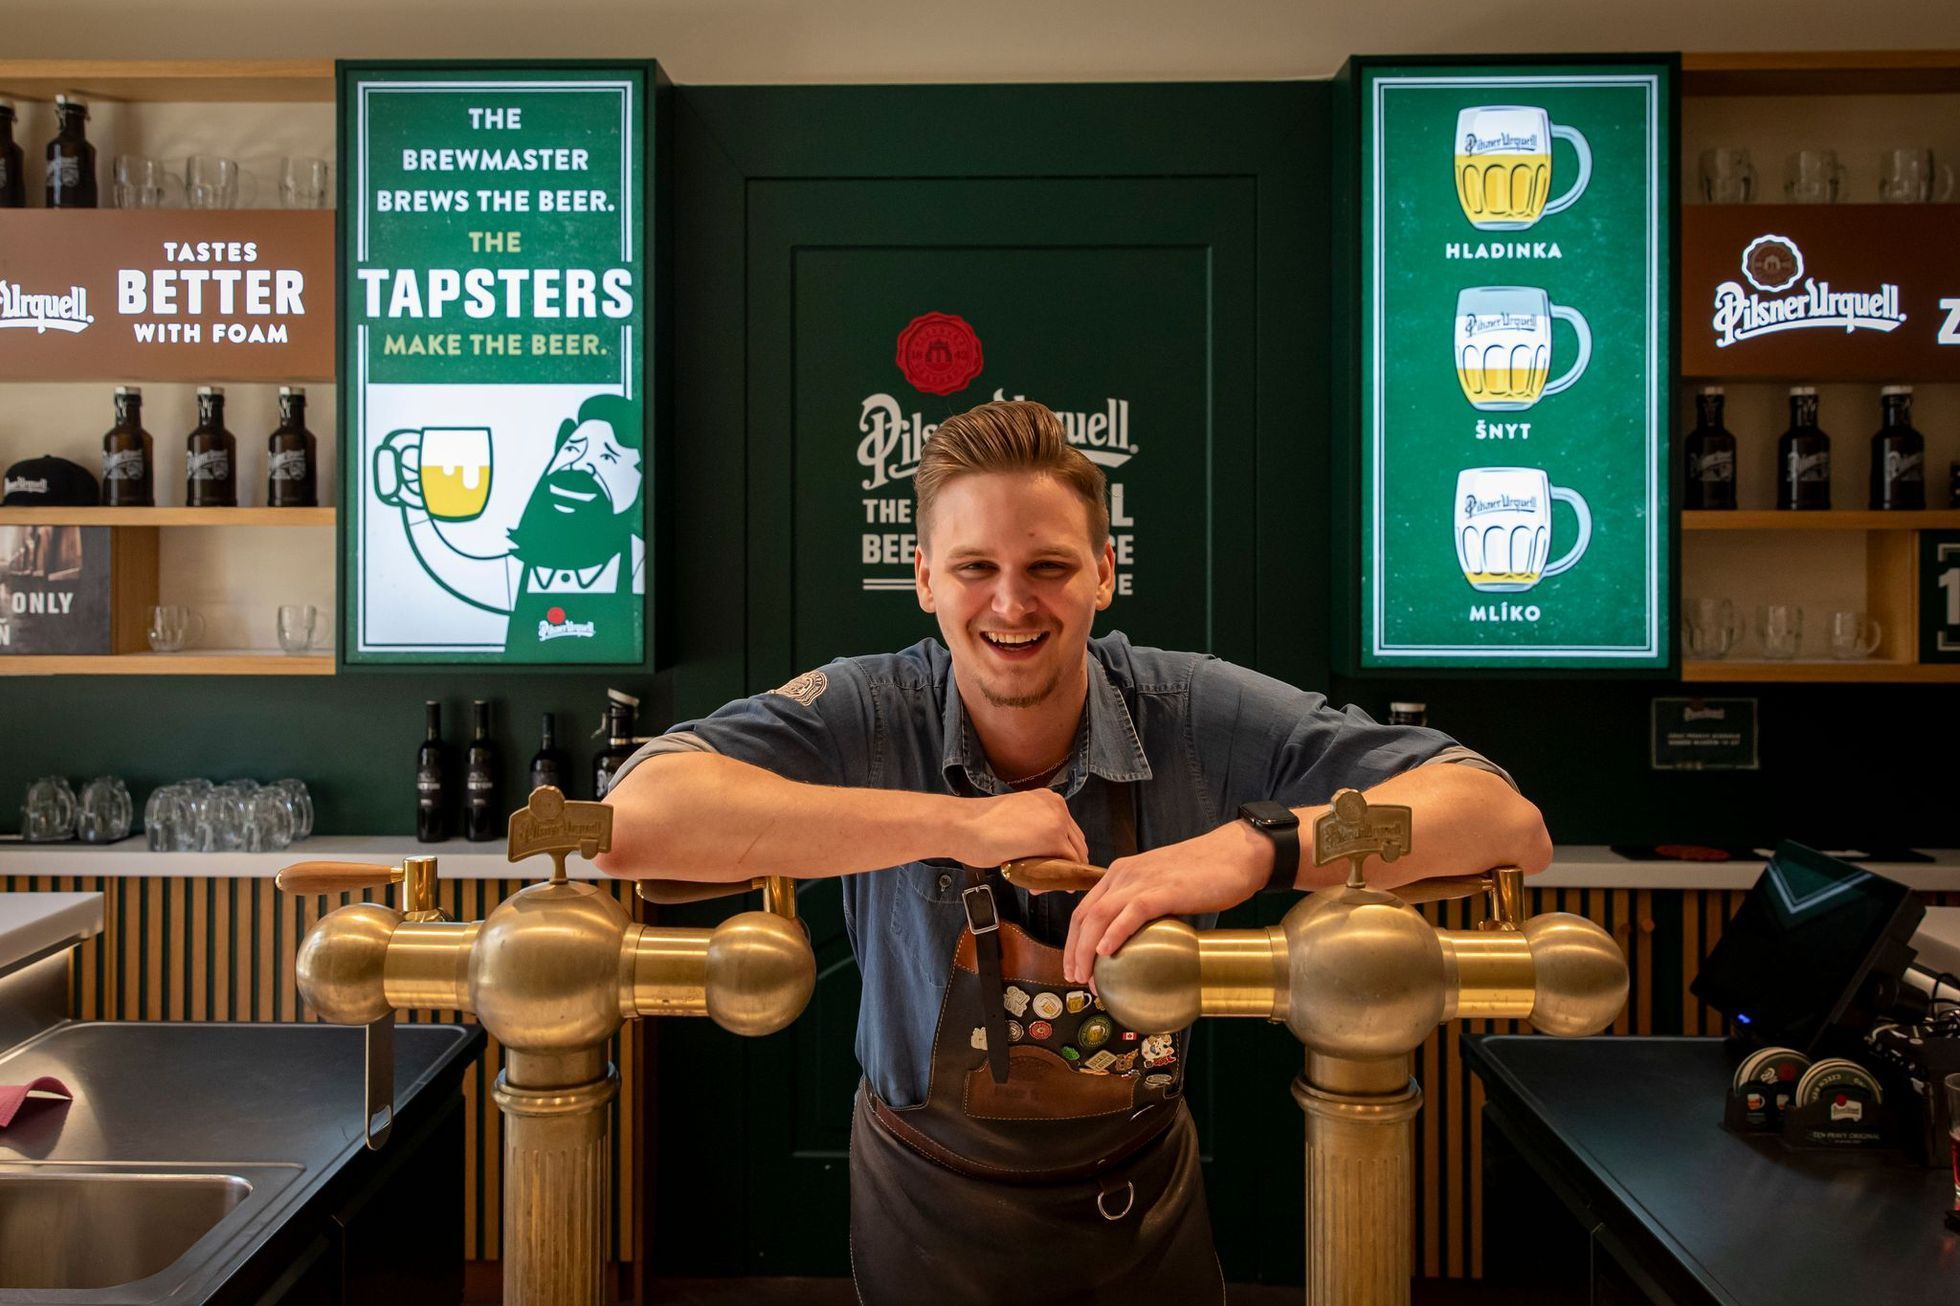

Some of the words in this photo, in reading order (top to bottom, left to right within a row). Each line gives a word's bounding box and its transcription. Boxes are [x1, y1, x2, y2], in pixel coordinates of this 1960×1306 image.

[468, 108, 522, 130] THE
[402, 149, 589, 171] BREWMASTER
[376, 190, 470, 212] BREWS
[477, 190, 530, 212] THE
[538, 190, 616, 212] BEER.
[163, 242, 258, 262] TASTES
[468, 231, 522, 253] THE
[1445, 242, 1563, 260] HLADINKA
[117, 269, 306, 315] BETTER
[357, 268, 633, 318] TAPSTERS
[1712, 281, 1810, 348] Pilsner
[133, 323, 201, 344] WITH
[212, 323, 289, 344] FOAM
[383, 334, 462, 356] MAKE
[469, 334, 522, 356] THE
[531, 334, 609, 356] BEER.
[1475, 419, 1532, 440] ŠNYT
[862, 498, 912, 524] THE
[862, 533, 917, 564] BEE
[11, 591, 74, 614] ONLY
[1469, 602, 1541, 622] MLÍKO
